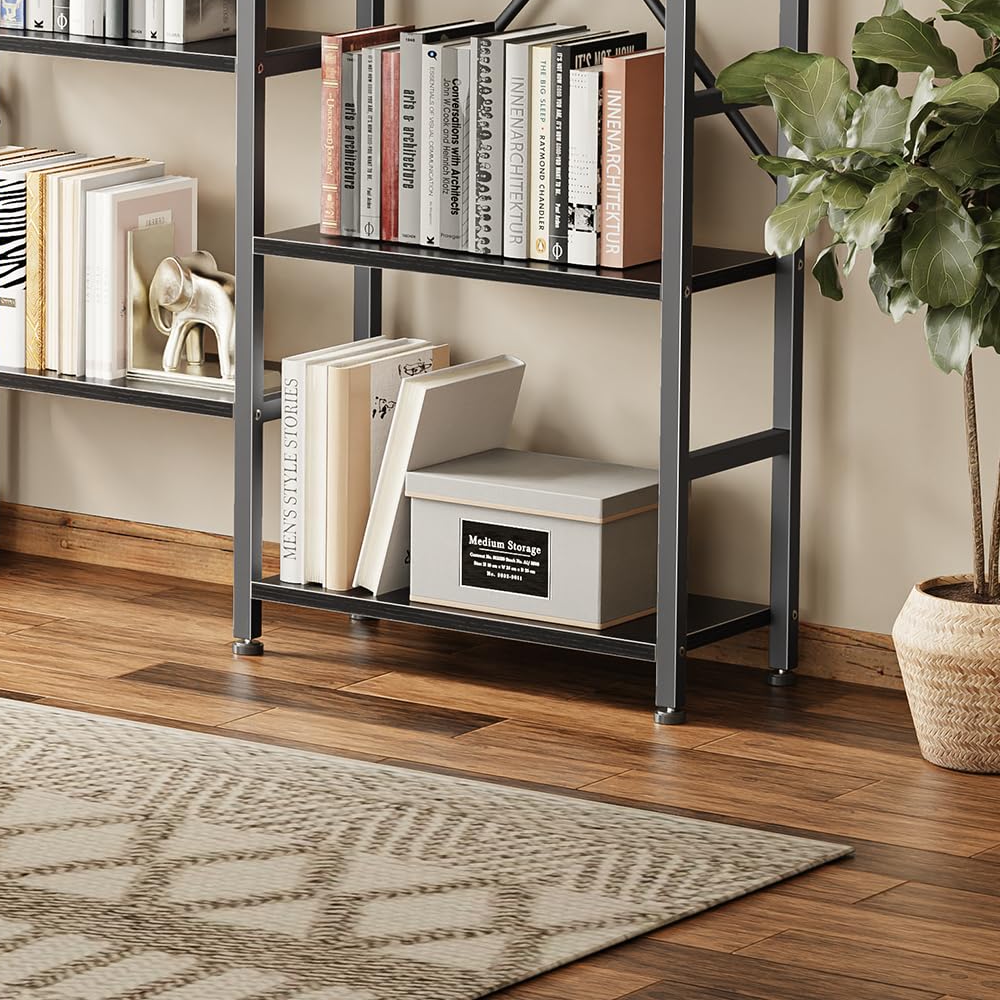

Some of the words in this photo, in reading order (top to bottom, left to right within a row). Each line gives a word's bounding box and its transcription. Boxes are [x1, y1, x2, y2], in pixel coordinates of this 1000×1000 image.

[344, 102, 355, 120] arts
[403, 89, 416, 110] arts
[452, 78, 460, 145] Conversations
[344, 134, 355, 190] architecture
[403, 126, 416, 189] architecture
[451, 146, 460, 166] with
[509, 76, 527, 245] INNENARCHITEKTUR
[605, 90, 622, 254] INNENARCHITEKTUR
[450, 168, 461, 216] Architects
[284, 378, 298, 449] STORIES
[284, 454, 298, 506] STYLE
[284, 510, 298, 560] MEN'S
[468, 534, 505, 549] Medium
[508, 540, 541, 556] Storage
